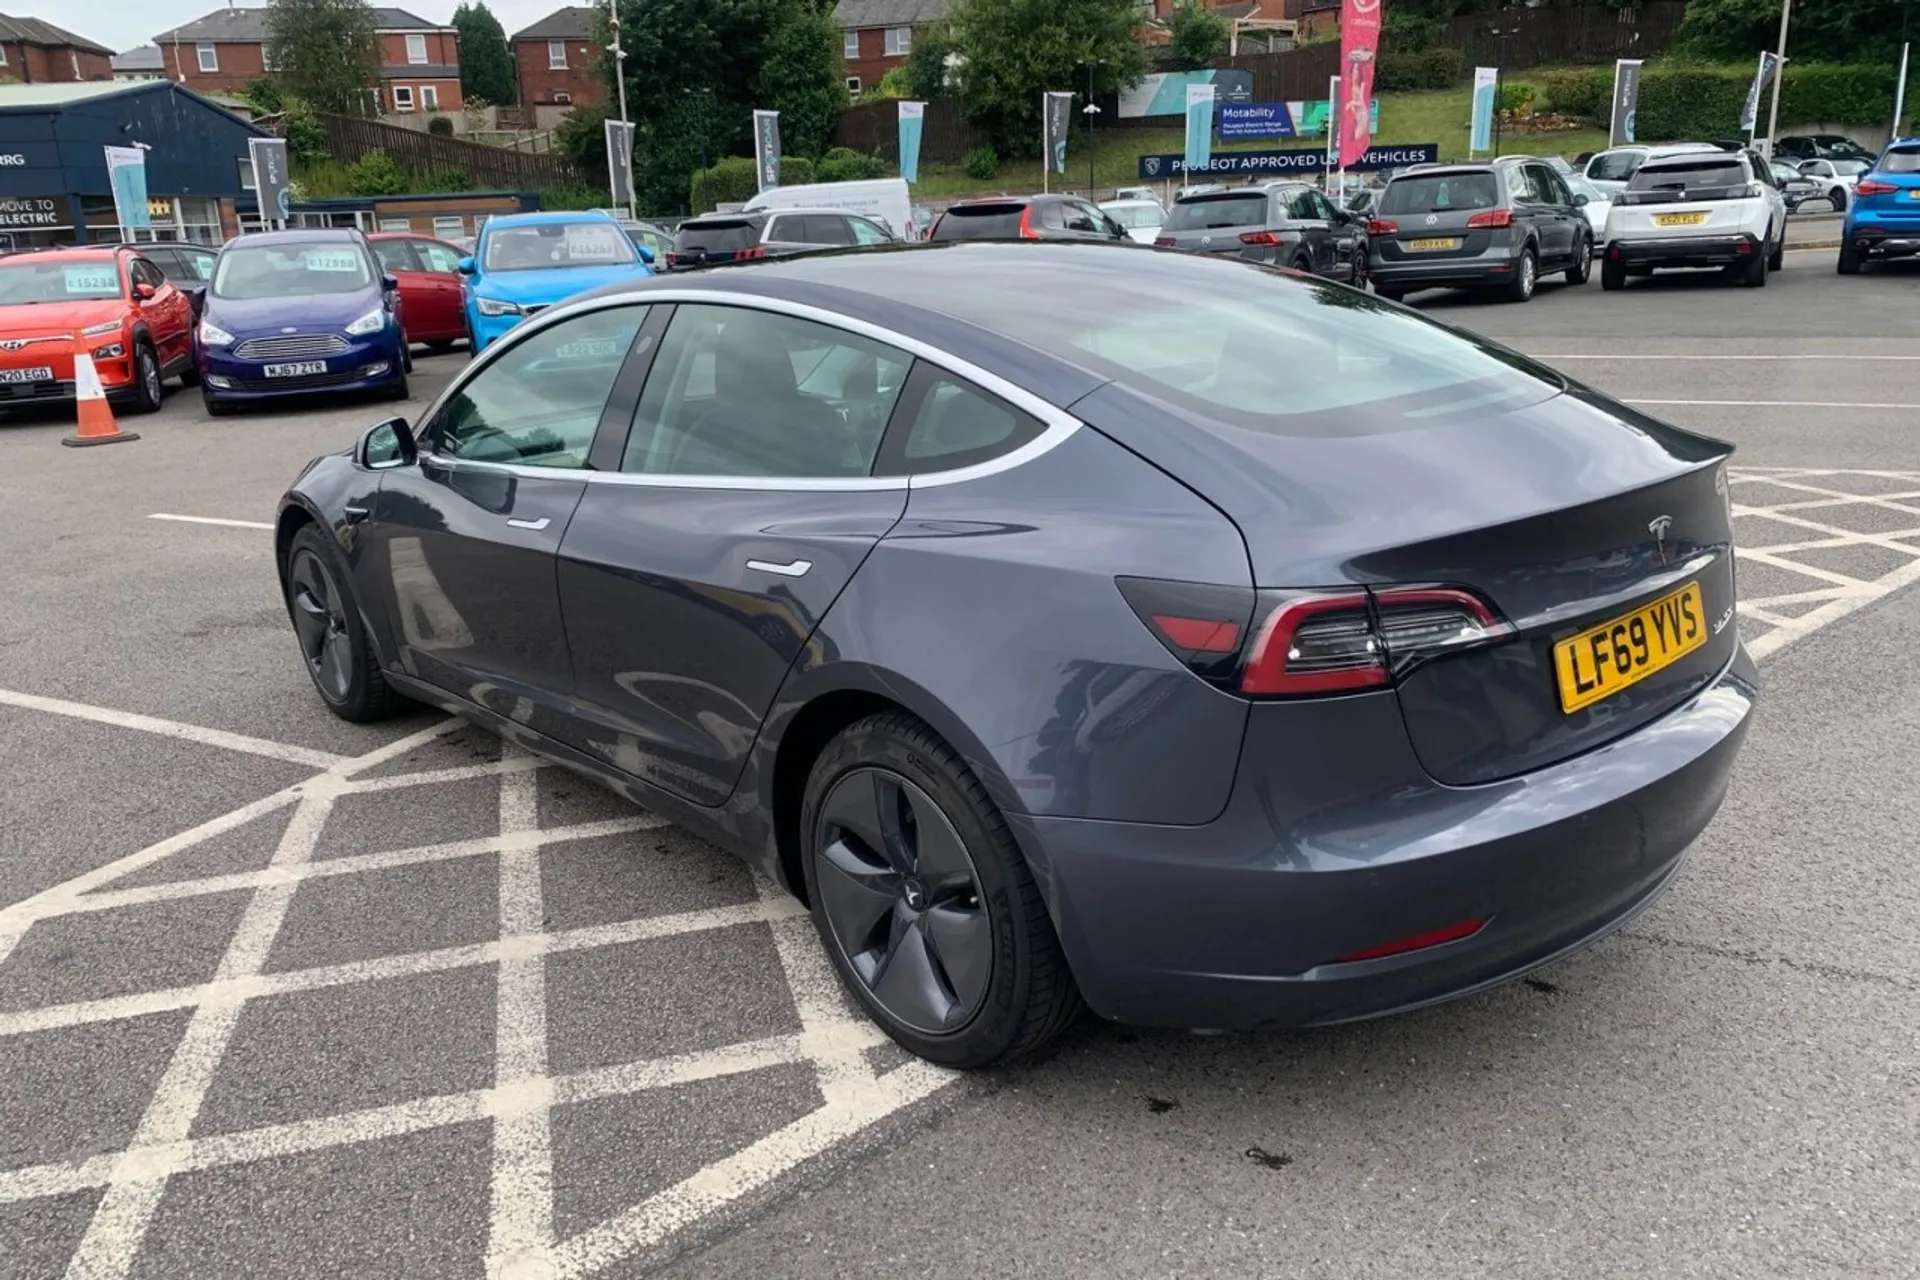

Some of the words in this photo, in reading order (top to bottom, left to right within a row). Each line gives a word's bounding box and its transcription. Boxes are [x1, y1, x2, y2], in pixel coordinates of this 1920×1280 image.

[1222, 107, 1275, 119] Motability
[1240, 154, 1317, 169] APPROVED
[1361, 150, 1426, 164] VEHICLES
[0, 200, 32, 212] MOVE
[36, 200, 54, 210] TO
[0, 213, 58, 225] ELECTRIC
[1569, 617, 1649, 695] LF69
[1650, 592, 1698, 655] YVS
